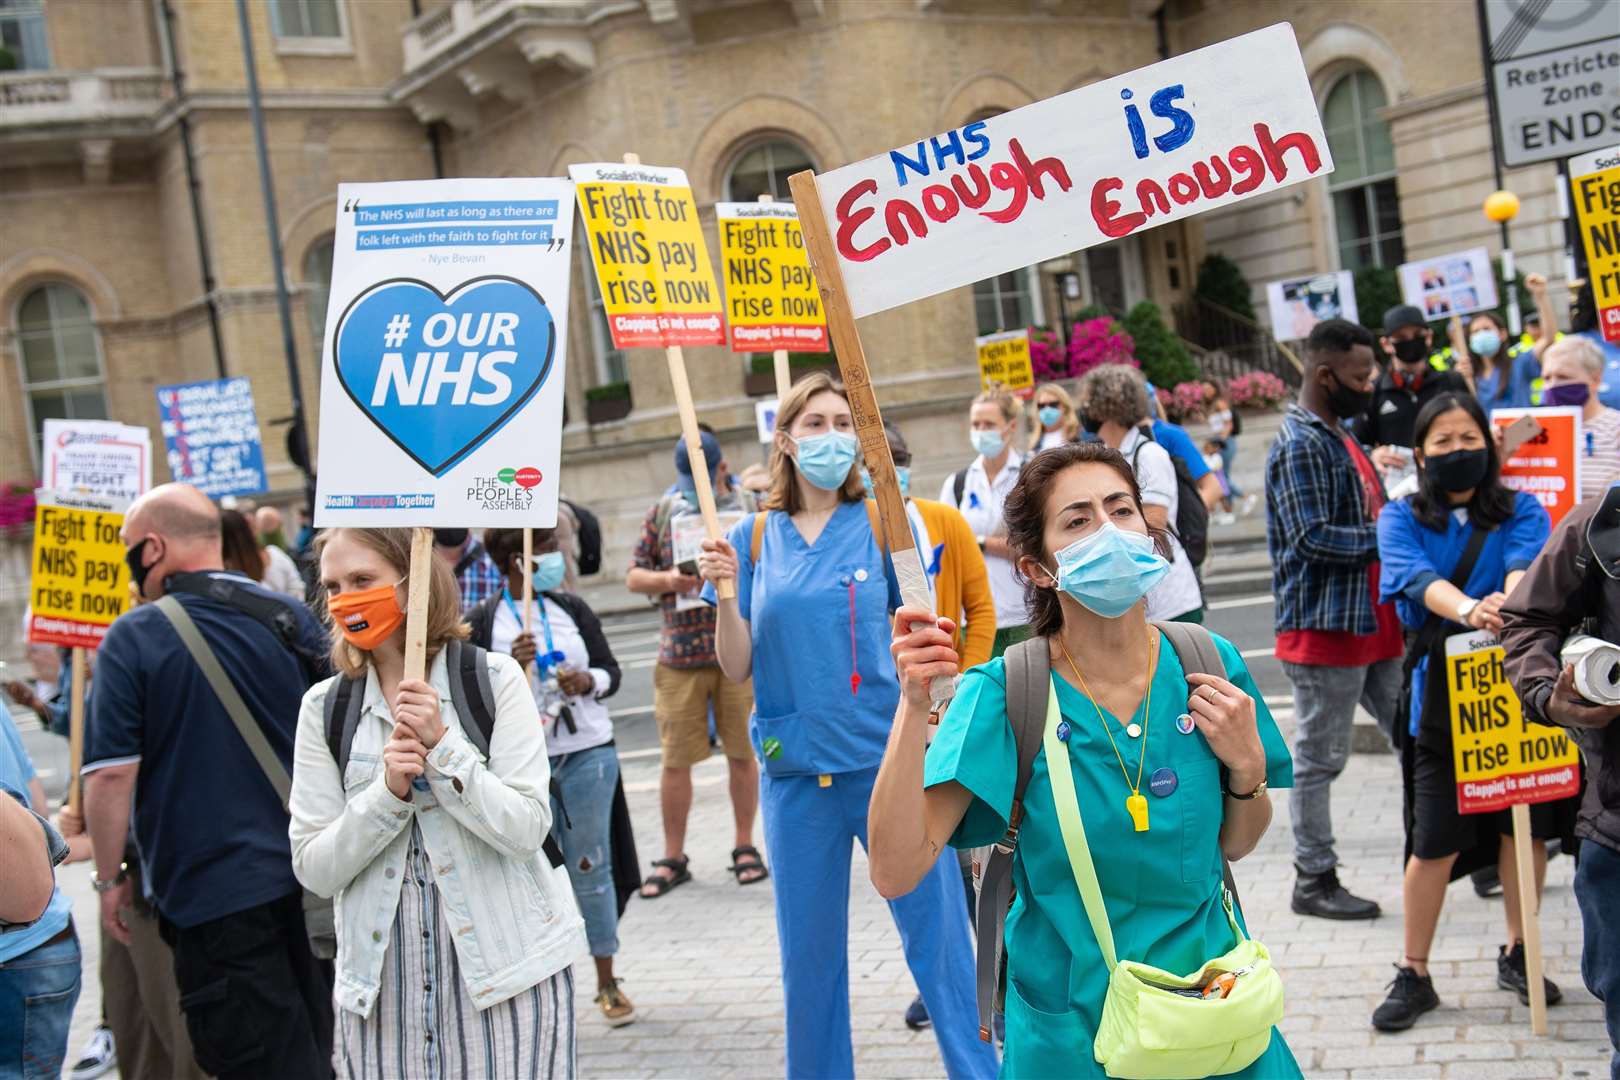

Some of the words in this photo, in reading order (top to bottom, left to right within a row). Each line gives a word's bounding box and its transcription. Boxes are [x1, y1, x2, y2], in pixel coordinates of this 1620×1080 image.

[1506, 52, 1620, 87] Restricte
[1543, 81, 1603, 106] Zone
[1119, 84, 1196, 159] is
[889, 121, 991, 186] NHS
[1090, 122, 1322, 238] Enough
[1581, 176, 1620, 216] Fig
[359, 211, 379, 221] The
[380, 209, 404, 220] NHS
[405, 208, 424, 219] will
[425, 207, 445, 218] last
[447, 208, 459, 217] as
[461, 205, 487, 219] long
[488, 207, 502, 216] as
[503, 205, 534, 216] there
[535, 207, 554, 216] are
[584, 186, 651, 227] Fight
[653, 189, 688, 222] for
[835, 137, 1073, 262] Enough
[359, 234, 380, 246] folk
[382, 233, 400, 245] left
[401, 232, 425, 244] with
[428, 231, 446, 242] the
[448, 230, 474, 241] faith
[477, 230, 489, 241] to
[491, 229, 519, 243] fight
[521, 229, 537, 240] for
[595, 231, 651, 265] NHS
[656, 240, 697, 272] pay
[725, 222, 778, 255] Fight
[784, 222, 803, 249] fo
[428, 254, 449, 266] Nye
[452, 253, 486, 264] Bevan
[729, 258, 773, 285] NHS
[781, 265, 812, 291] pay
[607, 271, 657, 305] rise
[665, 279, 711, 304] now
[1600, 262, 1620, 299] ri
[732, 290, 773, 317] rise
[782, 297, 819, 317] now
[383, 313, 412, 348] #
[422, 312, 520, 347] OUR
[370, 350, 519, 407] NHS
[473, 477, 498, 488] THE
[395, 494, 434, 508] Together
[481, 500, 533, 510] ASSEMBLY
[41, 509, 86, 545] Fight
[95, 515, 122, 545] for
[38, 547, 77, 578] NHS
[84, 560, 120, 590] pay
[36, 580, 74, 611] rise
[81, 593, 122, 616] now
[1468, 636, 1502, 651] Social
[1454, 652, 1506, 695] Figh
[1458, 695, 1510, 735] NHS
[1462, 740, 1509, 773] rise
[1520, 735, 1569, 763] now
[1463, 780, 1506, 799] Clapping
[1506, 776, 1517, 790] is
[1518, 776, 1536, 789] not
[1537, 768, 1573, 786] enough
